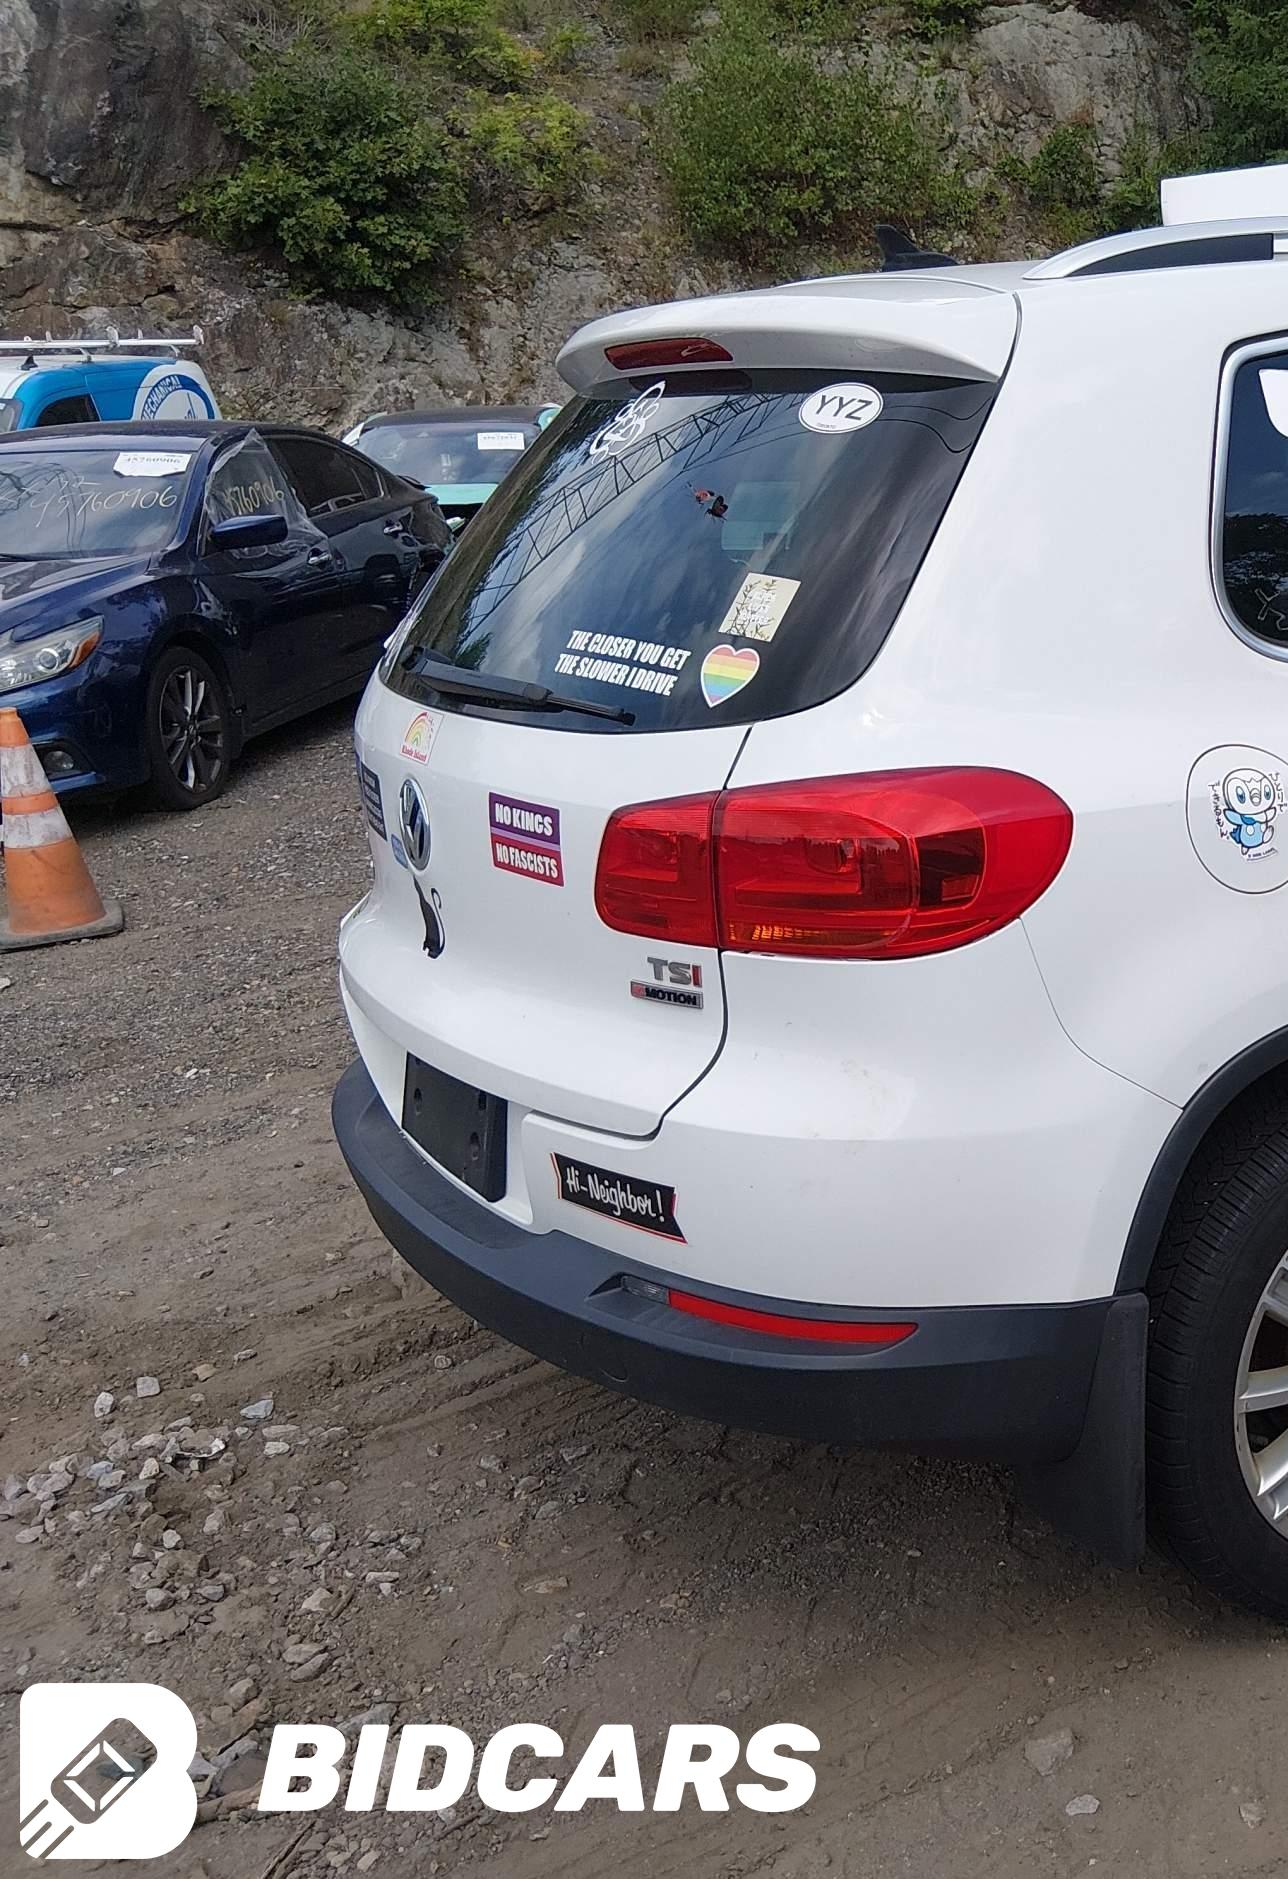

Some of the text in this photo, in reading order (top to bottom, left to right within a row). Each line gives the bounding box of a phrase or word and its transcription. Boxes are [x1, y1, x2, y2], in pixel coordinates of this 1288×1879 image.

[815, 395, 873, 421] YYZ
[566, 630, 691, 671] THE CLOSER YOU GET
[554, 653, 678, 696] THE SLOWER I DRIVE
[495, 803, 553, 836] NO KINGS
[495, 842, 558, 878] NO FASCISTS
[647, 957, 702, 988] TSI
[566, 1166, 665, 1222] Hi-Neighbor!
